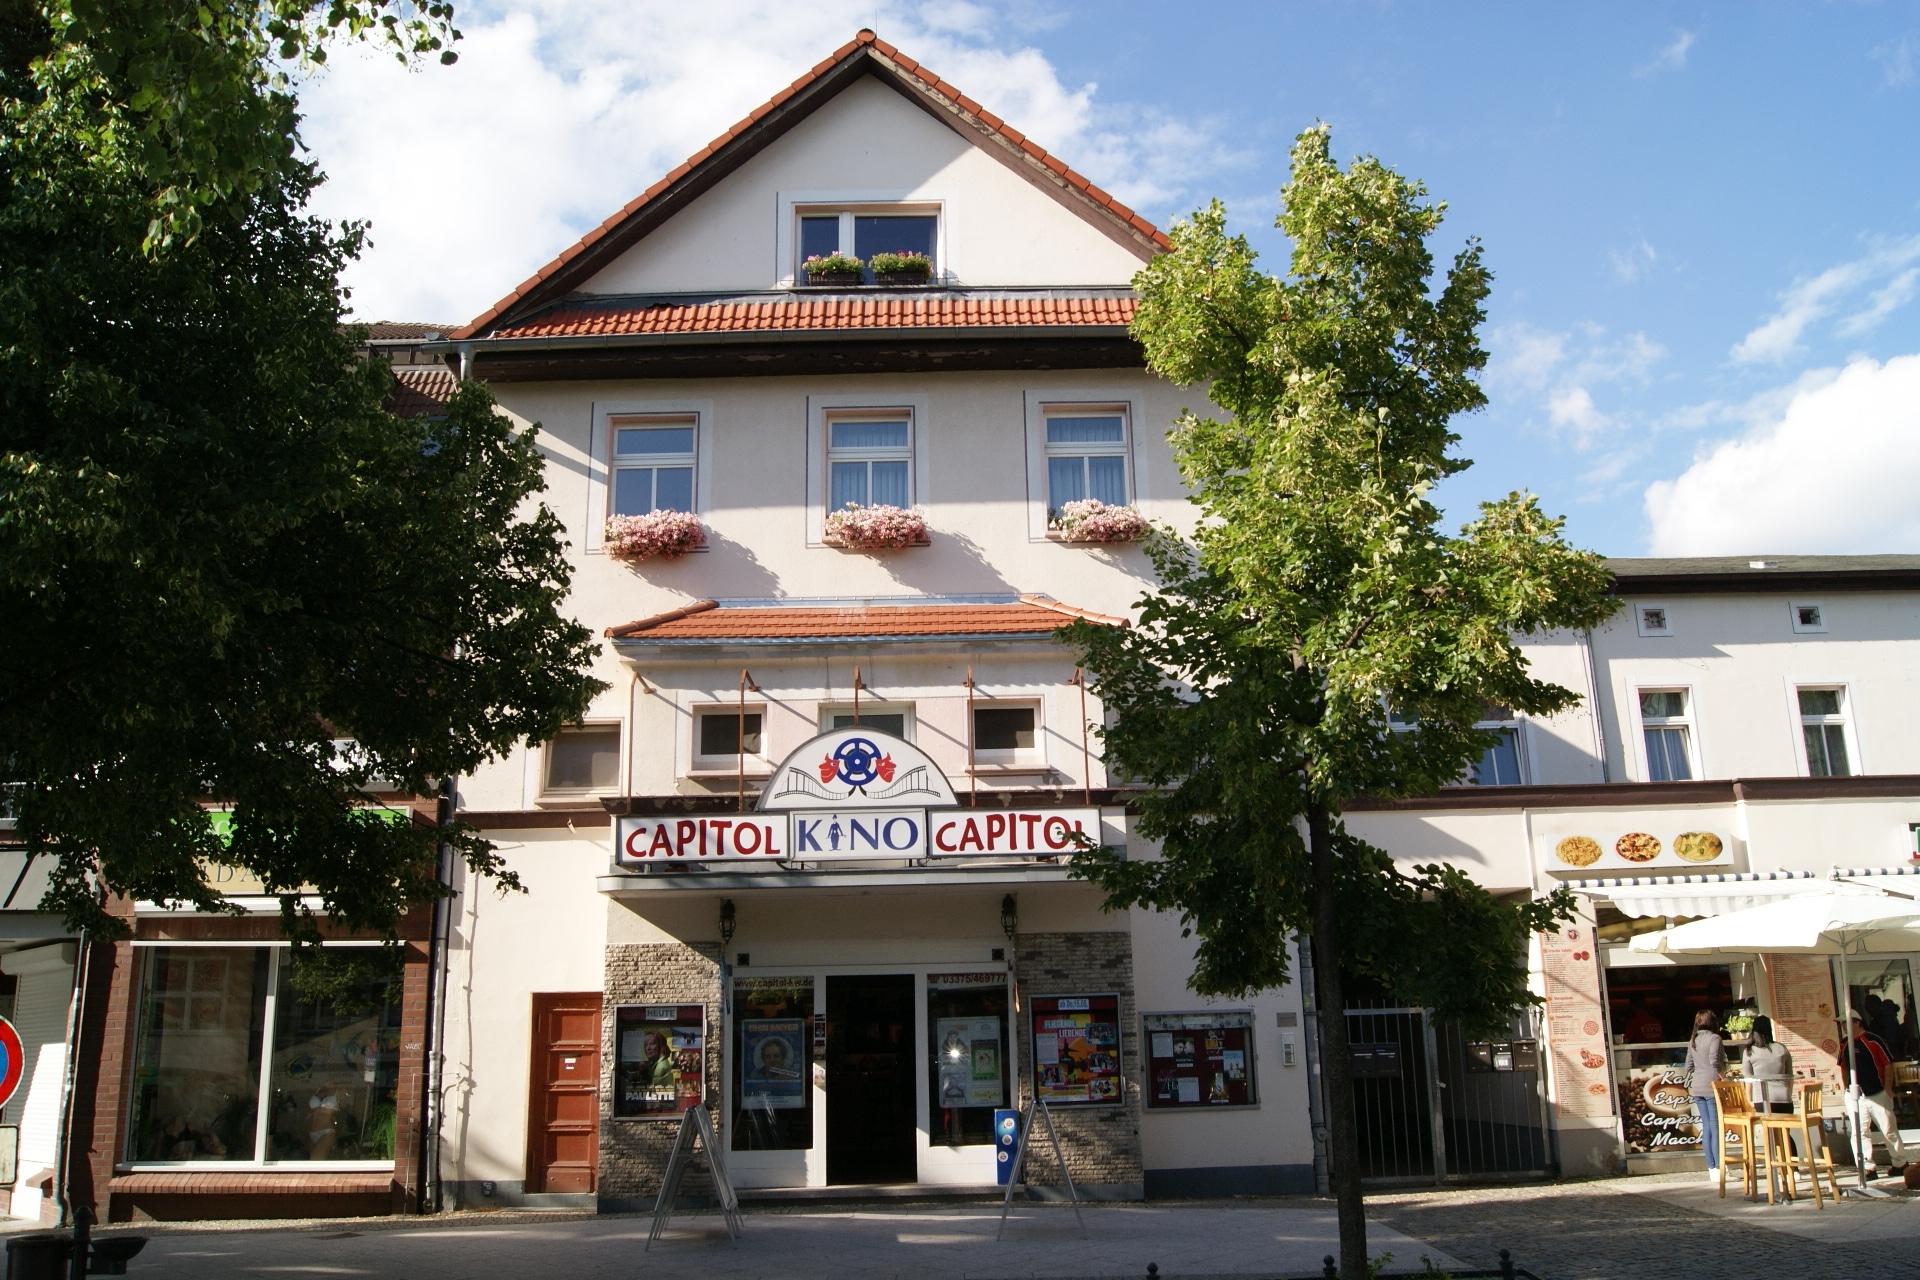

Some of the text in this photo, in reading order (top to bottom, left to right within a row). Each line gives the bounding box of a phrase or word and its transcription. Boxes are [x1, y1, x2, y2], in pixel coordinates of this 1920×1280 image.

[625, 819, 781, 857] CAPITOL
[935, 813, 1092, 852] CAPITOL
[647, 1009, 675, 1017] HEUTE
[625, 1091, 675, 1101] PAULETTE
[1653, 1092, 1696, 1109] Espr
[1641, 1112, 1703, 1130] Cappu
